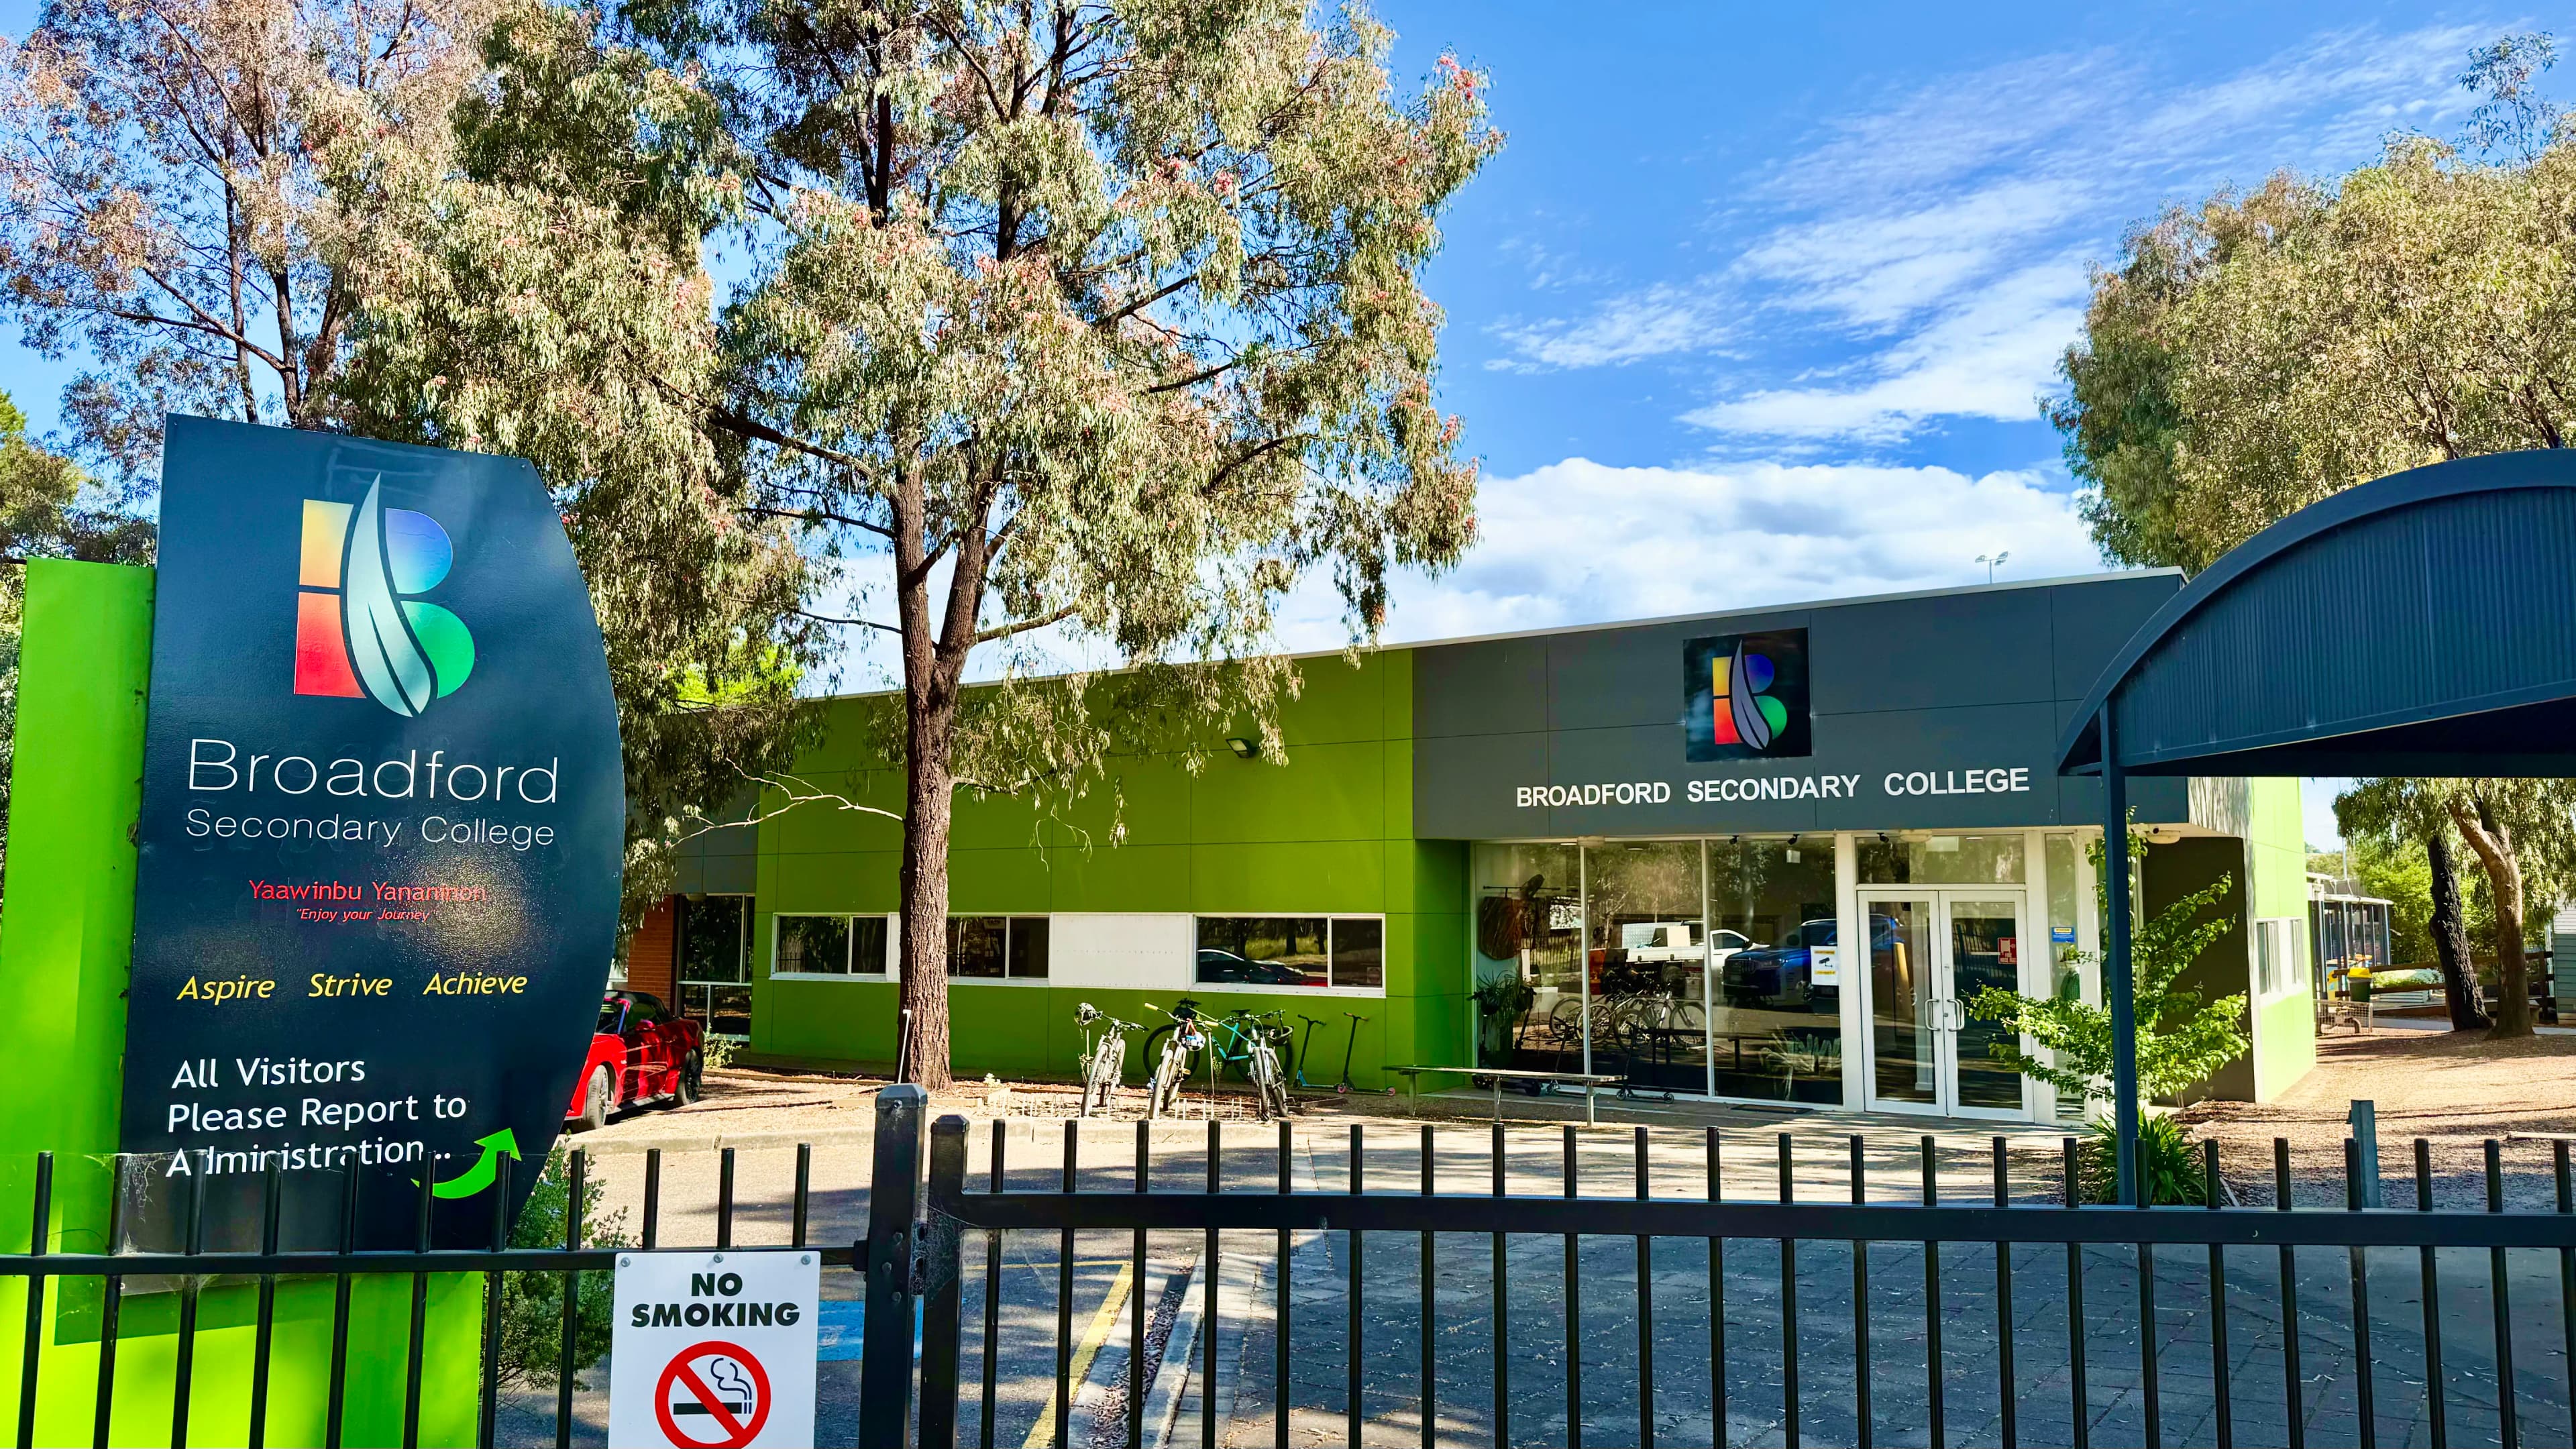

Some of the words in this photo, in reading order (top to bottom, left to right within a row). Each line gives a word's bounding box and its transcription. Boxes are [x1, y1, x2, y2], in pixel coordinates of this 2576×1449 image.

[189, 739, 558, 804] Broadford
[1516, 782, 1670, 808] BROADFORD
[1687, 774, 1862, 803] SECONDARY
[1884, 767, 2031, 796] COLLEGE
[186, 808, 401, 847] Secondary
[421, 816, 555, 851] College
[249, 879, 362, 900] Yaawinbu
[297, 908, 337, 923] "Enjoy
[343, 912, 373, 923] your
[177, 977, 276, 1005] Aspire
[309, 975, 392, 998] Strive
[423, 972, 529, 996] Achieve
[171, 1059, 219, 1089] All
[235, 1057, 366, 1086] Visitors
[168, 1103, 287, 1133] Please
[301, 1095, 419, 1132] Report
[433, 1094, 466, 1119] to
[691, 1273, 743, 1297] NO
[631, 1302, 800, 1328] SMOKING
